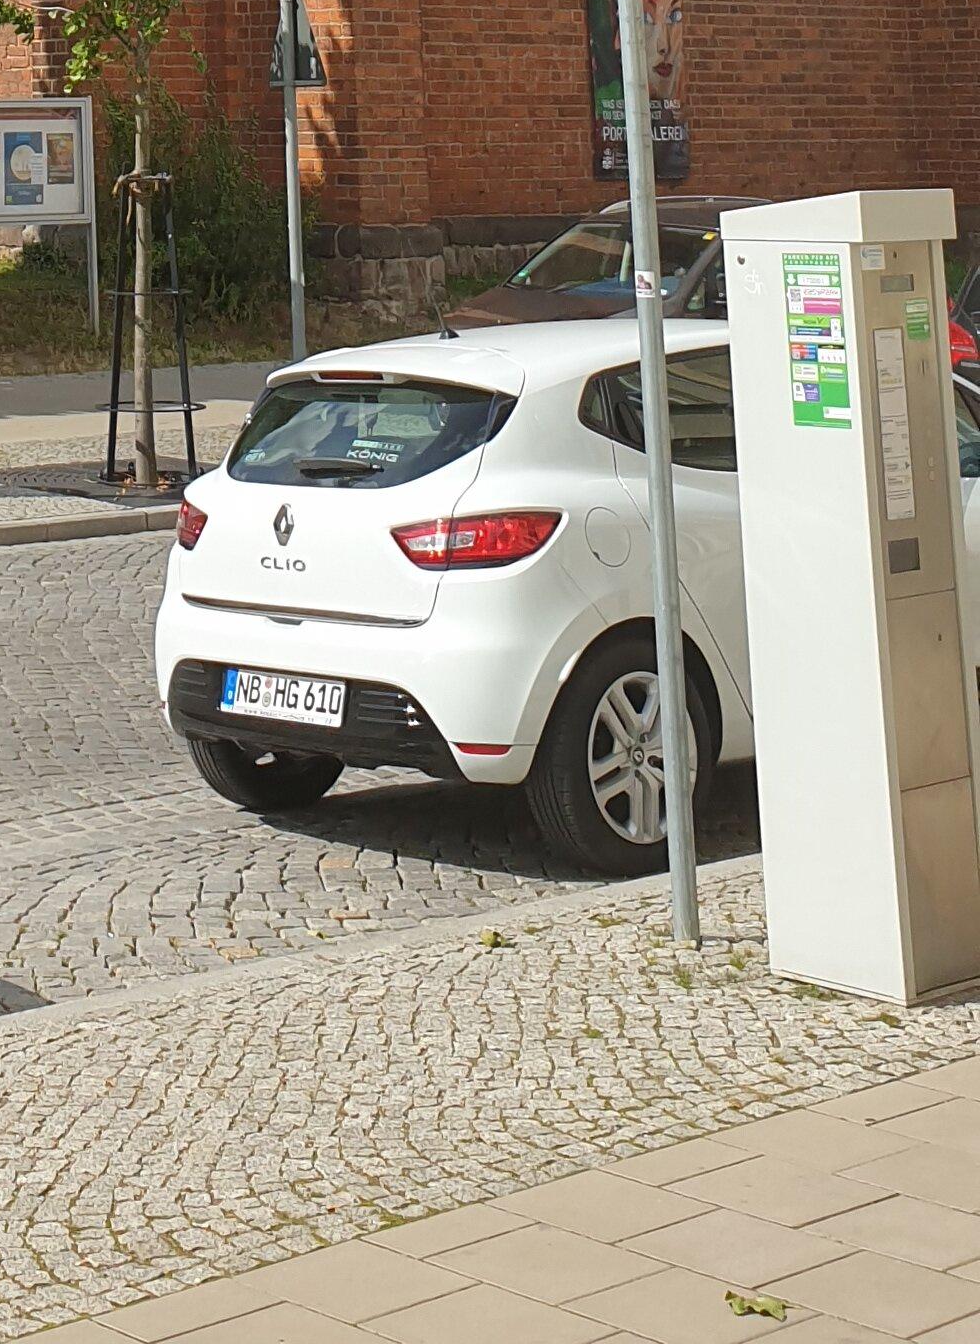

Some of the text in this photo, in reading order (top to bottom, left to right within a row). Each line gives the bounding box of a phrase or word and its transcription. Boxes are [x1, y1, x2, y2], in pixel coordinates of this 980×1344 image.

[346, 449, 399, 463] KÖNIG
[260, 556, 306, 572] CLIO
[236, 674, 342, 715] NB HG 610
